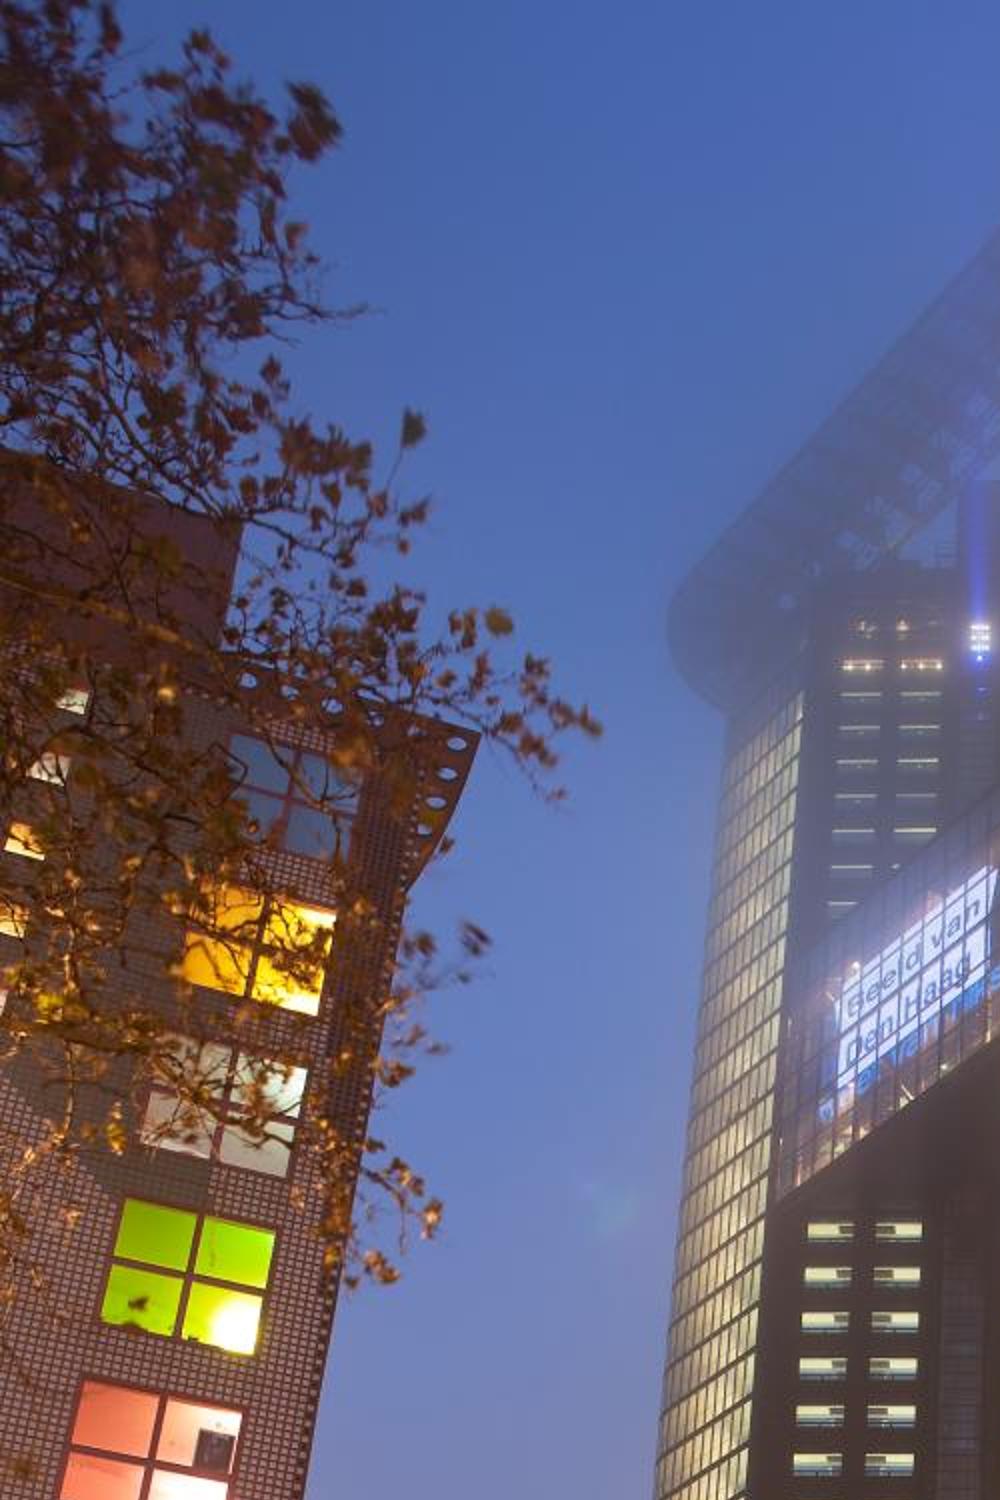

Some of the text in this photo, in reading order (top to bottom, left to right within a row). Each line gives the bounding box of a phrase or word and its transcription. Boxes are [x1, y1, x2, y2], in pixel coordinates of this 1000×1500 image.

[847, 943, 922, 1017] Beed
[931, 900, 980, 948] van
[847, 1016, 894, 1069] Den
[903, 952, 971, 1021] Haag
